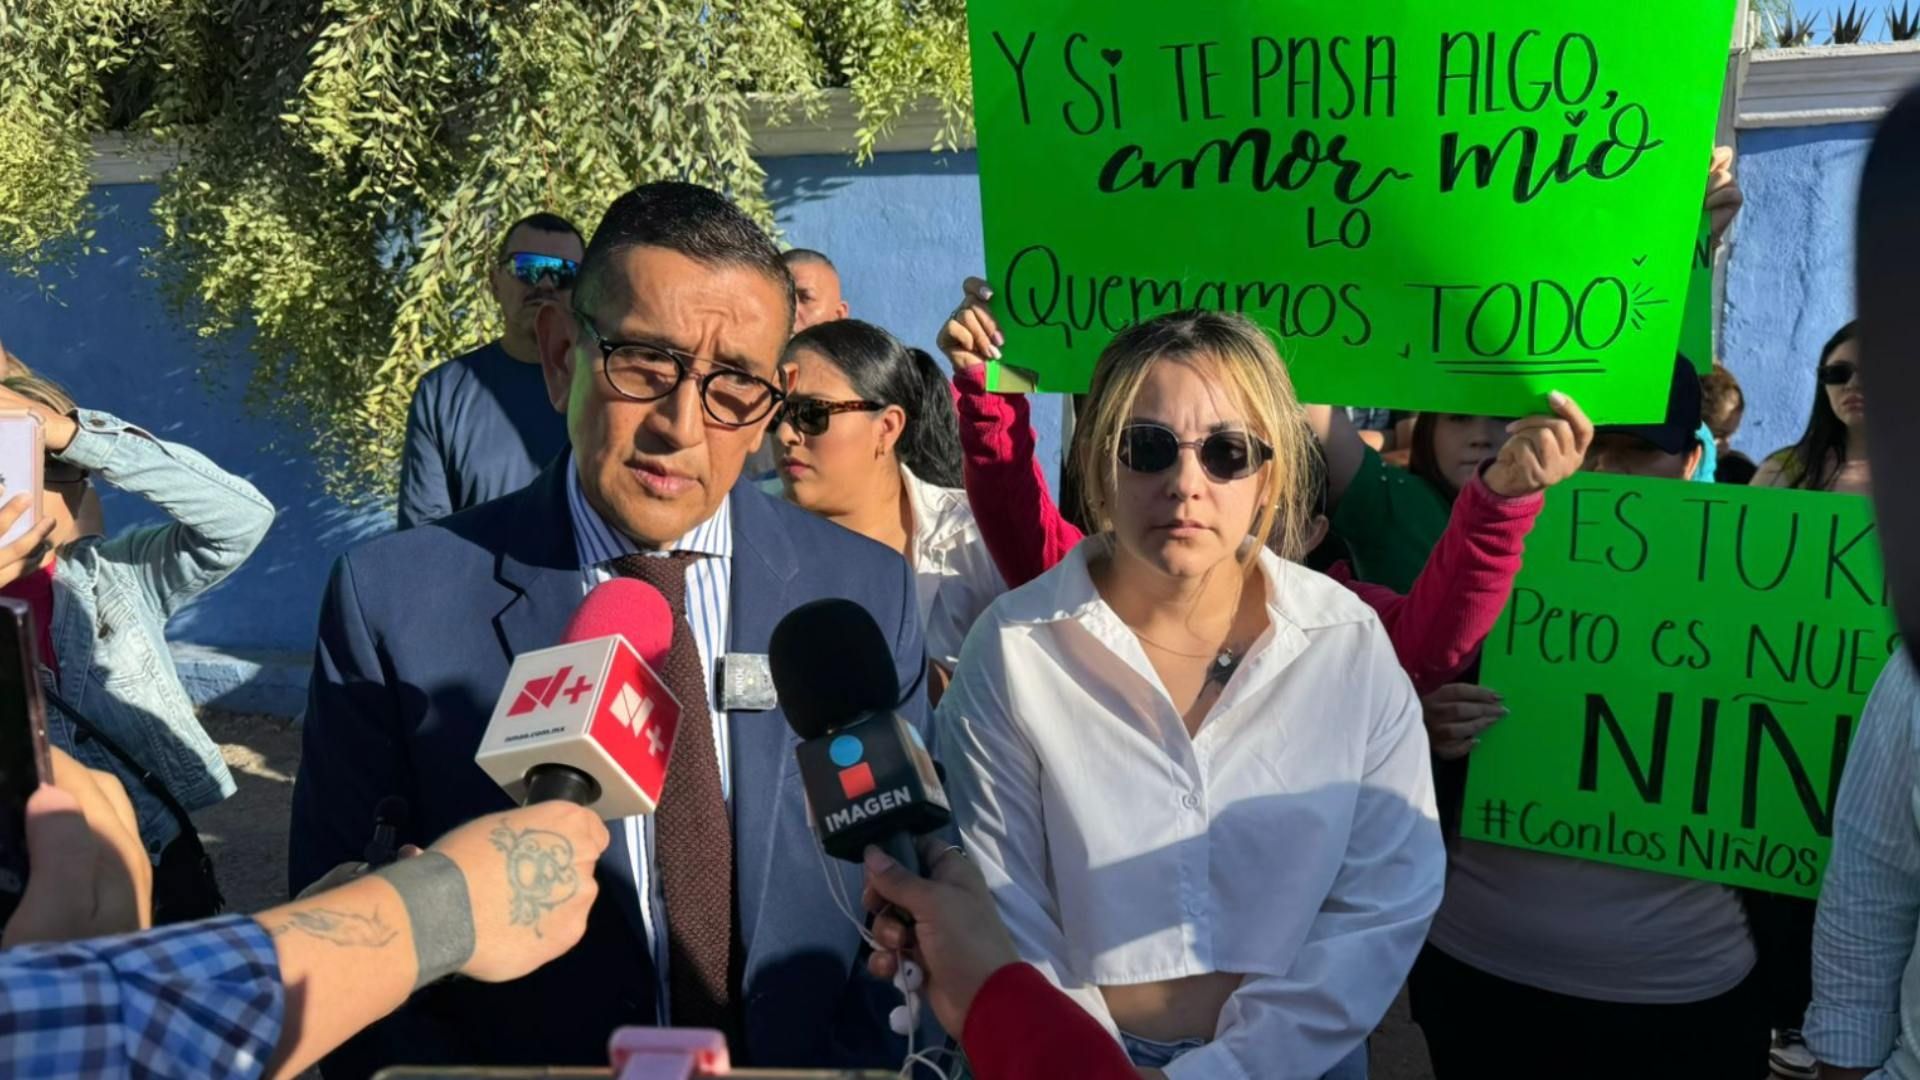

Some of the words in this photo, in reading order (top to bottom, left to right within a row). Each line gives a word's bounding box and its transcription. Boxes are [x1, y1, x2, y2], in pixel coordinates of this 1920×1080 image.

[992, 30, 1036, 125] Y
[1159, 41, 1227, 122] TE
[1251, 34, 1397, 120] PASA
[1436, 28, 1618, 117] ALGO,
[1097, 127, 1413, 205] amor
[1306, 207, 1371, 249] LO
[1569, 488, 1649, 573] ES
[1683, 498, 1799, 592] TU
[1506, 586, 1620, 665] Pero
[1651, 618, 1712, 670] es
[825, 785, 912, 833] IMAGEN
